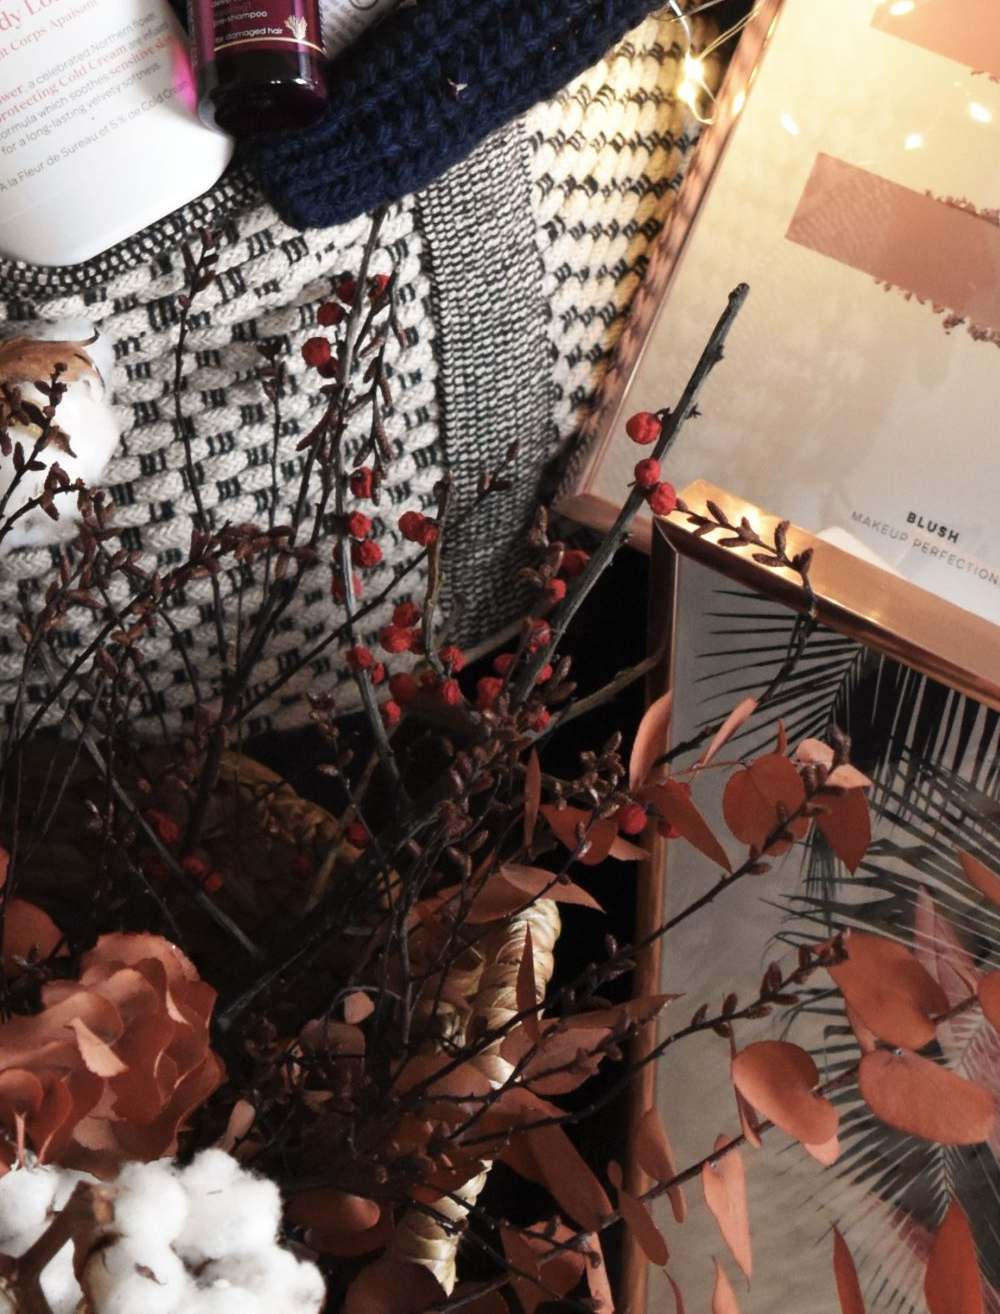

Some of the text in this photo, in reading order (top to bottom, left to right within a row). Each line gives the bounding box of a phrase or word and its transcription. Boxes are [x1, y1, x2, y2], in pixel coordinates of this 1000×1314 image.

[10, 28, 47, 52] Corps
[226, 27, 266, 40] damaged
[267, 26, 283, 35] hair
[36, 47, 91, 85] celebrated
[58, 65, 88, 87] Cold
[88, 45, 127, 70] Cream
[38, 96, 69, 118] which
[69, 73, 110, 101] soothes
[1, 142, 16, 155] for
[19, 139, 26, 147] a
[26, 104, 88, 142] long-lasting
[88, 85, 121, 109] velvety
[7, 177, 18, 187] la
[17, 162, 44, 182] Fleur
[46, 153, 61, 166] de
[60, 133, 98, 159] Sureau
[98, 126, 109, 136] et
[851, 511, 999, 585] MAKEUP PERFECTION
[906, 511, 959, 544] BLUSH
